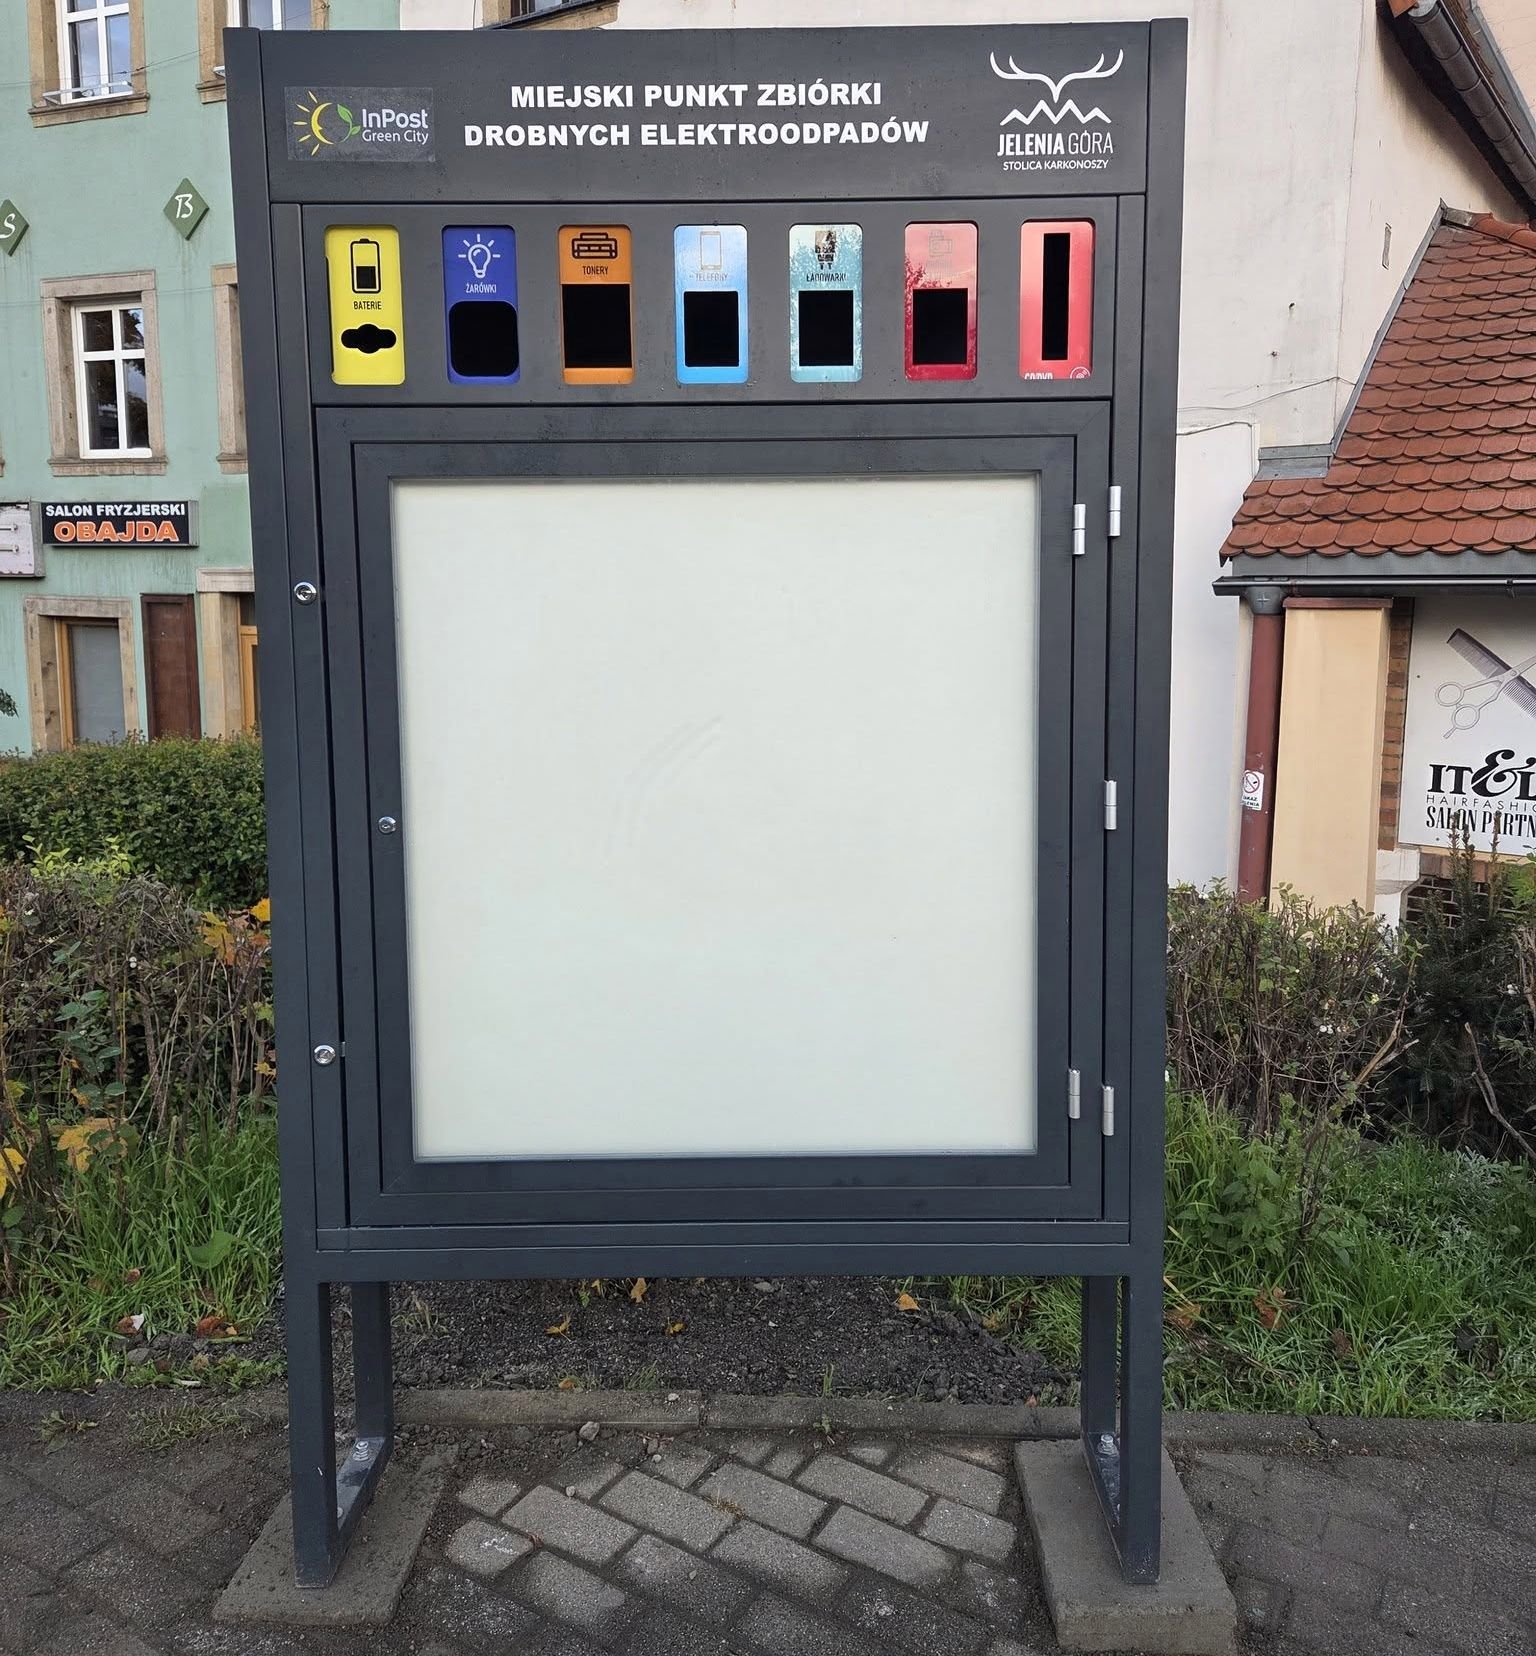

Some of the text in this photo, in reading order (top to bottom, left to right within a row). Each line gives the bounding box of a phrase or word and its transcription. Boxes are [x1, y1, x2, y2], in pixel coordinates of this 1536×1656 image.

[510, 78, 882, 108] MIEJSKI PUNKT ZBIÓRKI
[361, 108, 429, 129] InPost
[361, 129, 429, 145] Green City
[464, 116, 930, 147] DROBNYCH ELEKTROODPADÓW
[996, 129, 1114, 157] JELENIA GÓRA
[1002, 159, 1109, 171] STOLICA KARKONOSZY
[582, 265, 609, 276] TONERY
[465, 282, 497, 294] ŻARÓWKI
[353, 300, 383, 311] BATERIE
[45, 503, 186, 517] SALON FRYZJERSKI
[53, 520, 180, 542] OBAJDA
